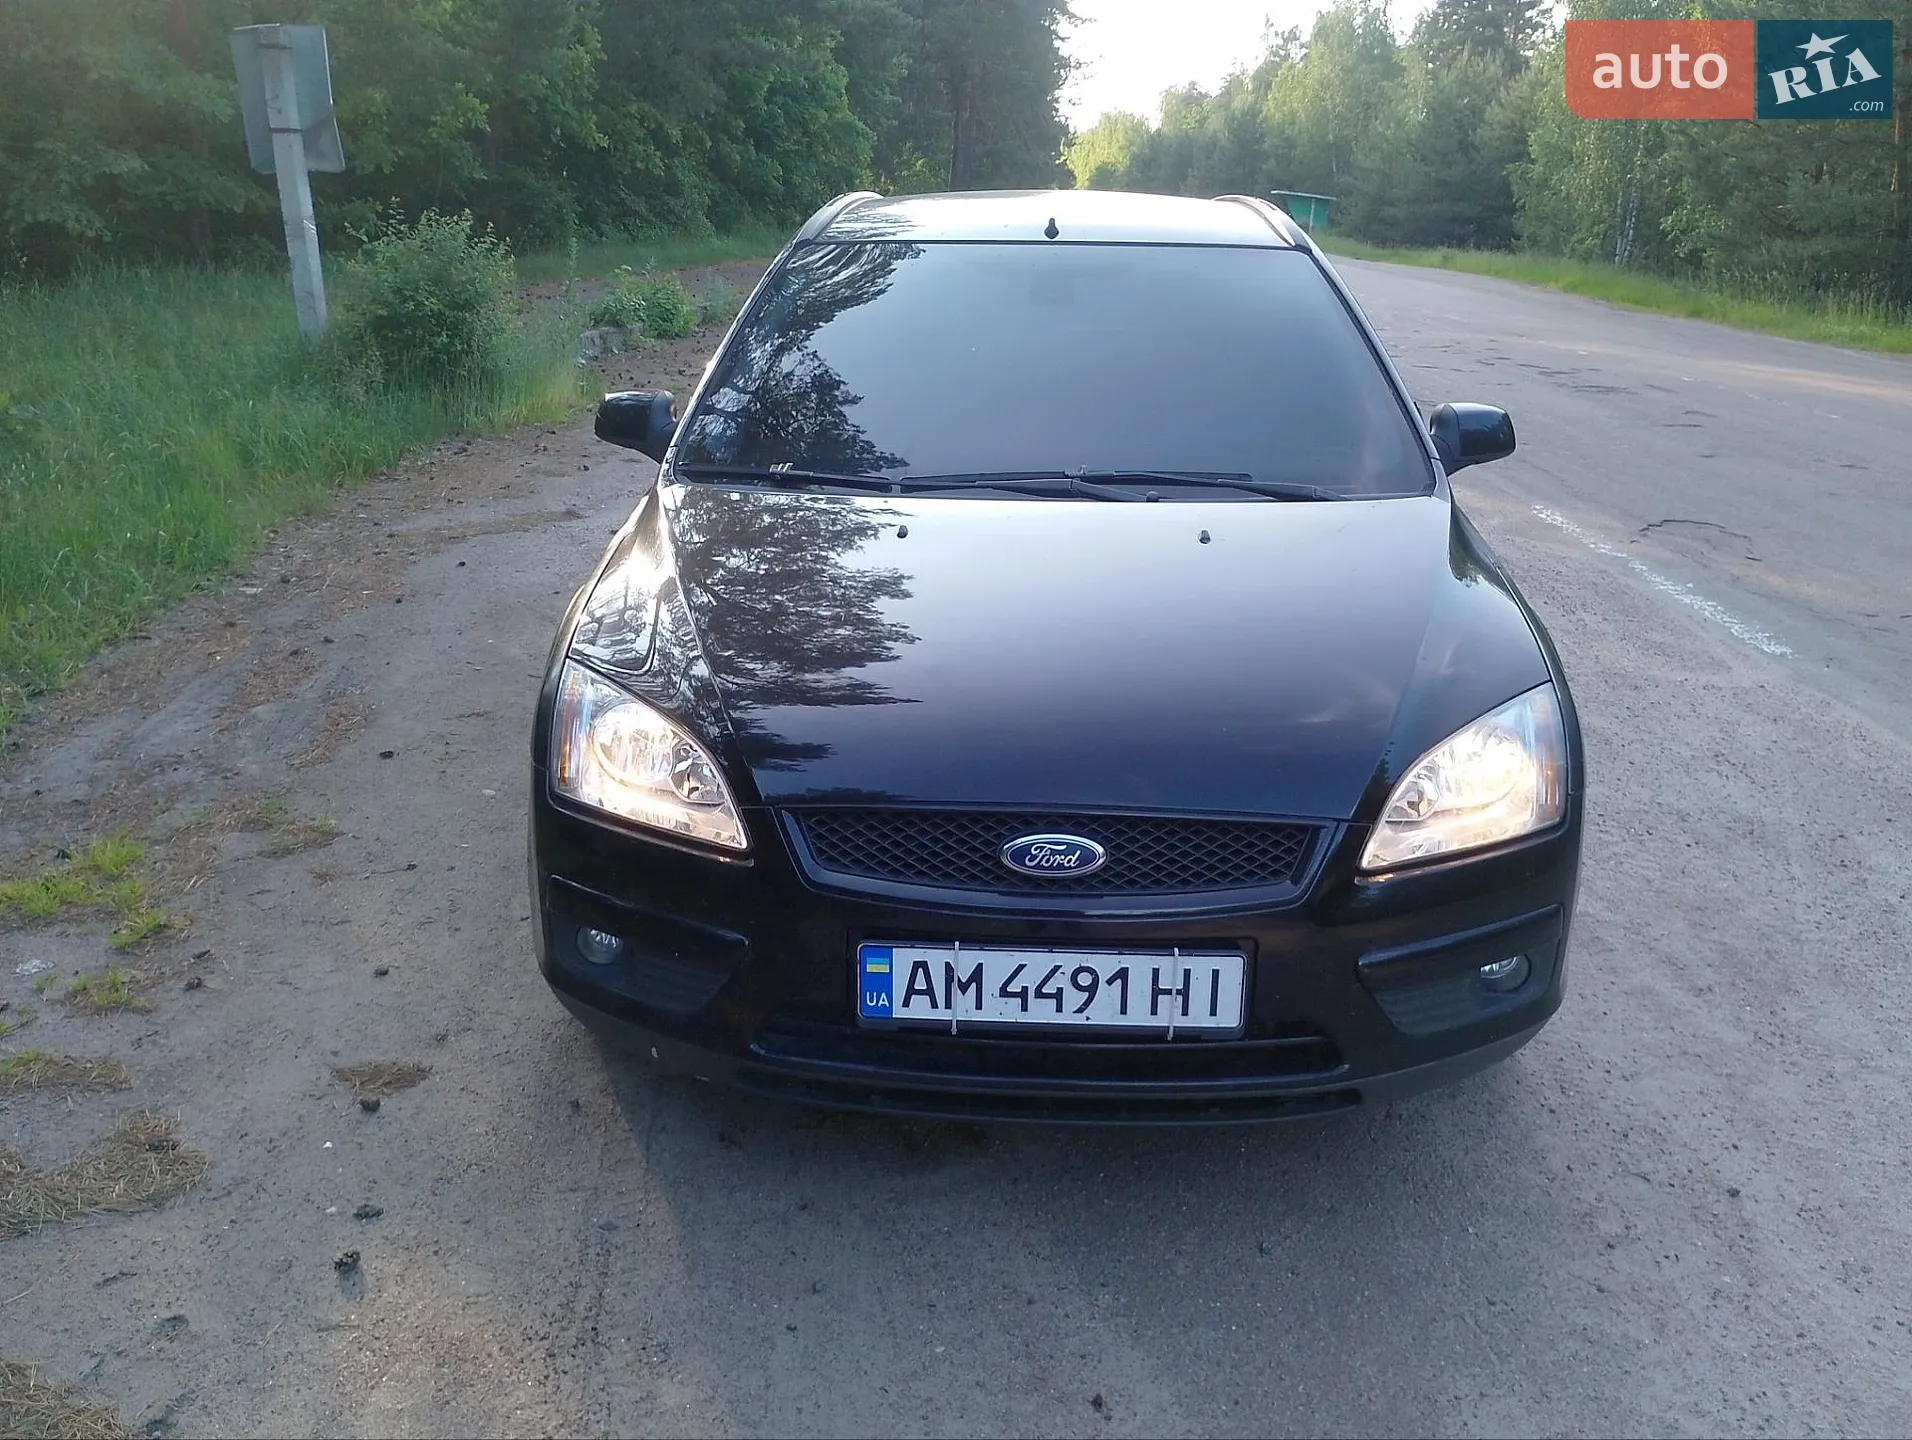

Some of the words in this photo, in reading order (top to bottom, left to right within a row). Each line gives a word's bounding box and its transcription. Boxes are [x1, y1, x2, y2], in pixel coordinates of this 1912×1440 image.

[1025, 843, 1081, 867] Ford
[866, 991, 889, 1007] UA
[902, 960, 984, 1011] AM
[999, 963, 1130, 1015] 4491
[1150, 967, 1220, 1017] HI
